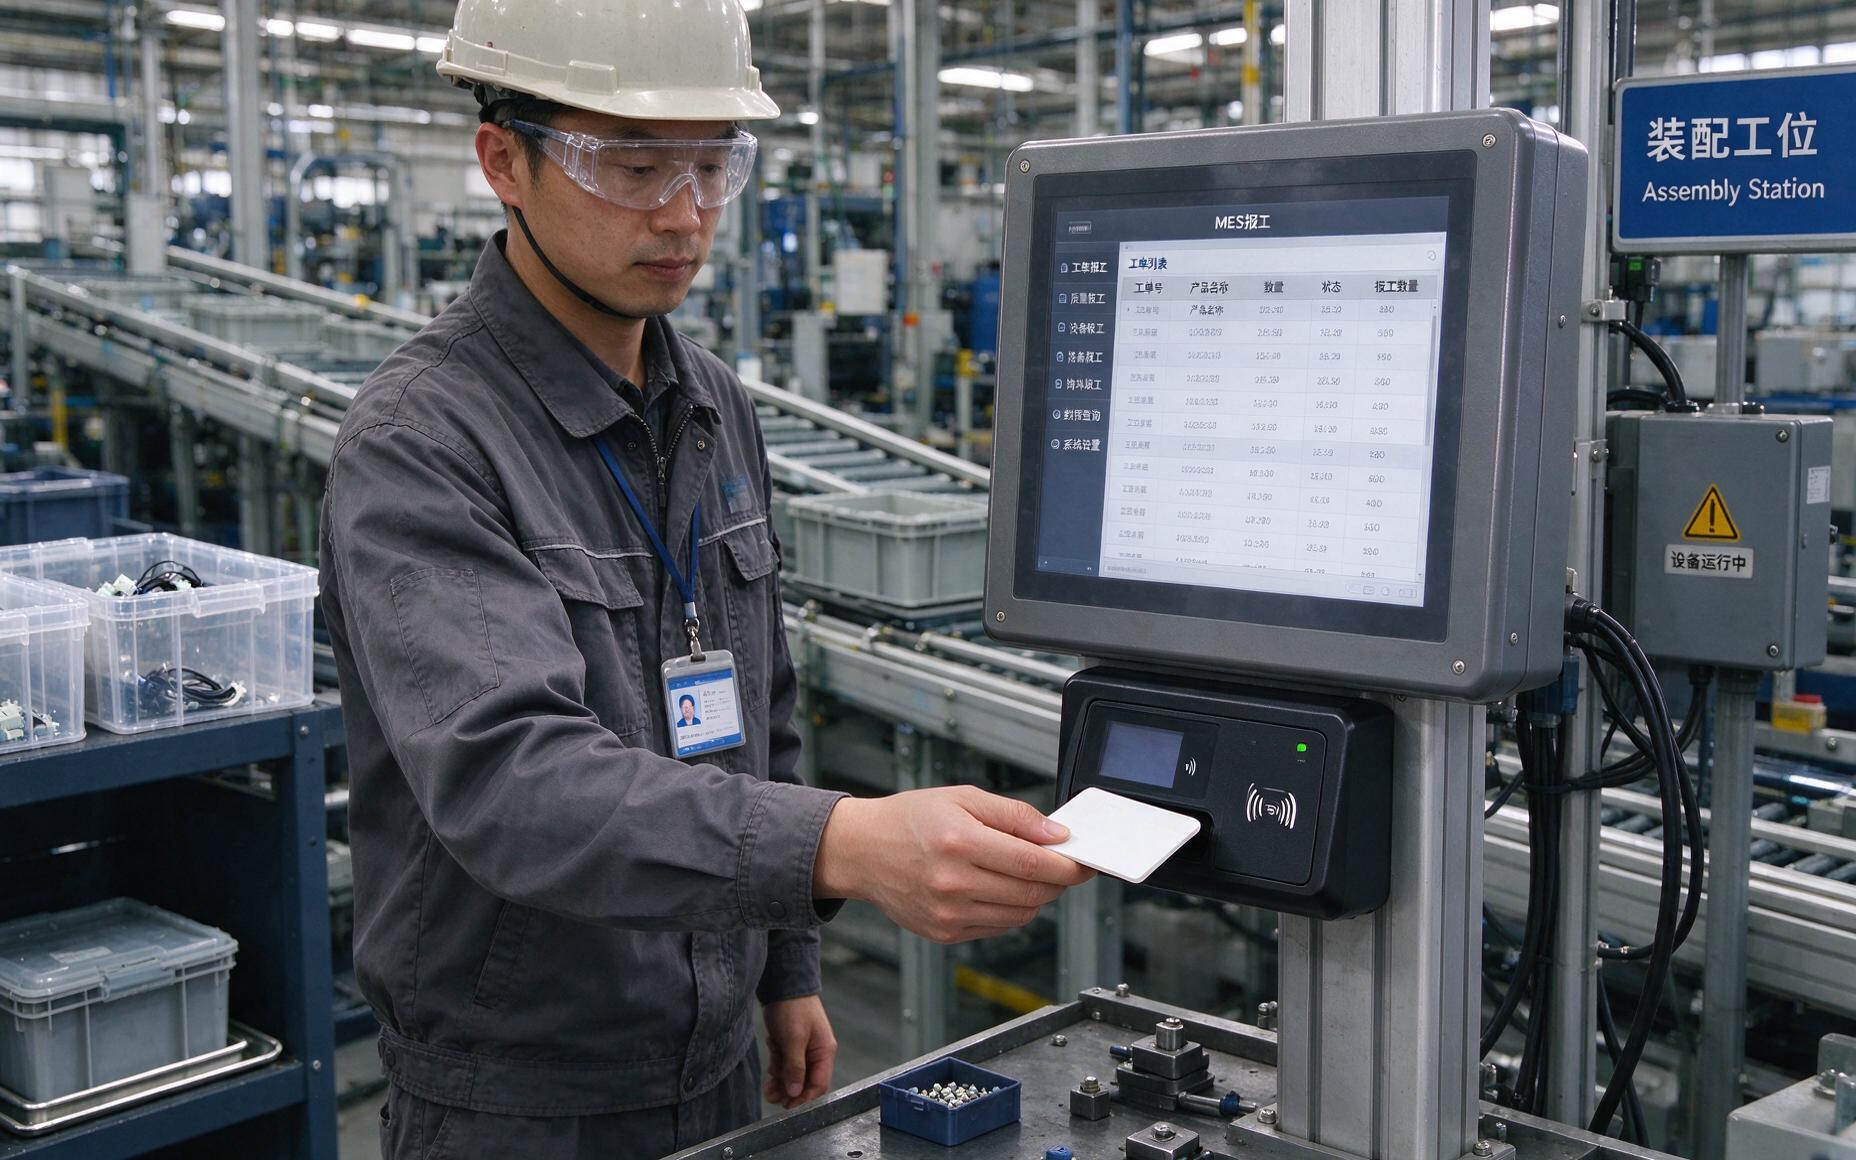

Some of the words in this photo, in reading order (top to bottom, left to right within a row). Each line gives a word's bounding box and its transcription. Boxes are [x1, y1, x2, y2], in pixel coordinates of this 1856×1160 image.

[1646, 111, 1818, 162] 装配工位
[1642, 178, 1741, 207] Assembly
[1749, 176, 1825, 199] Station
[1215, 213, 1271, 230] MES报工
[1671, 550, 1746, 573] 设备运行中
